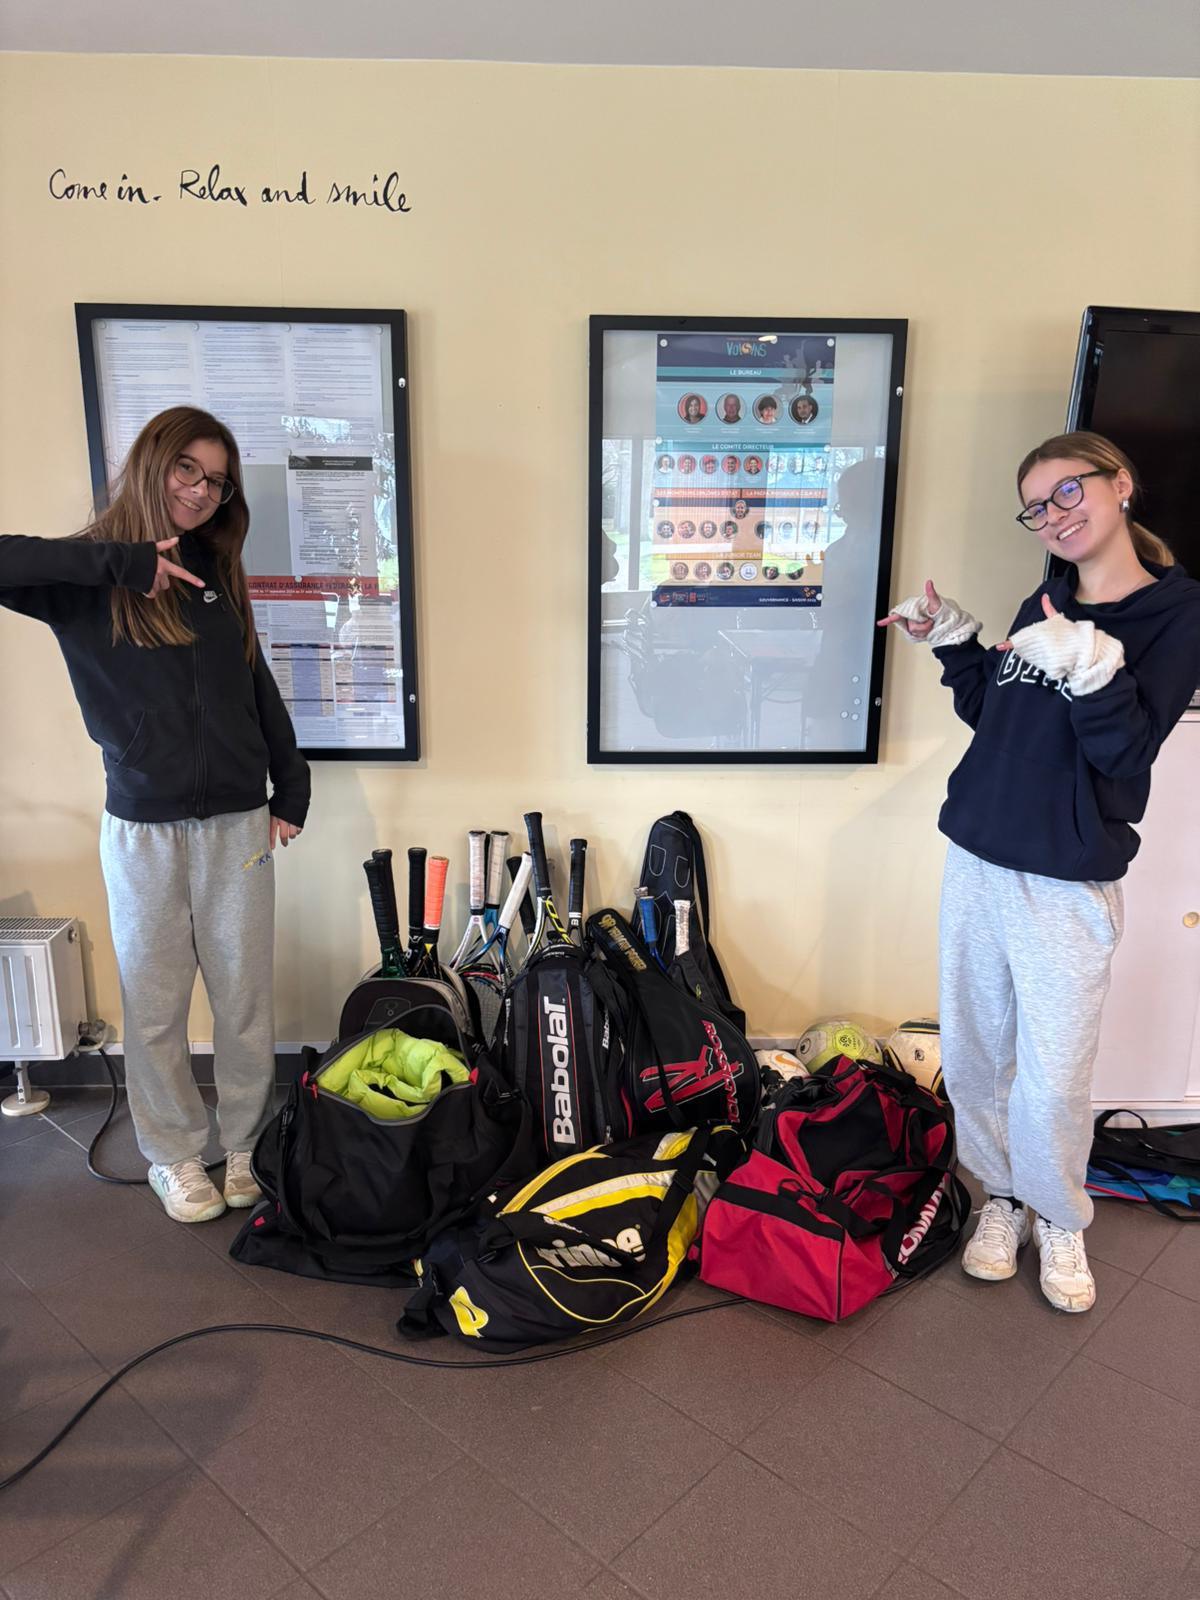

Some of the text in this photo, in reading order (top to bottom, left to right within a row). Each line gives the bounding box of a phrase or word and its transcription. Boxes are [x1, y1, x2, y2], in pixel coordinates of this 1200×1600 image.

[49, 168, 107, 201] Come
[179, 164, 248, 207] Relax
[261, 171, 316, 205] and
[327, 171, 412, 213] smile
